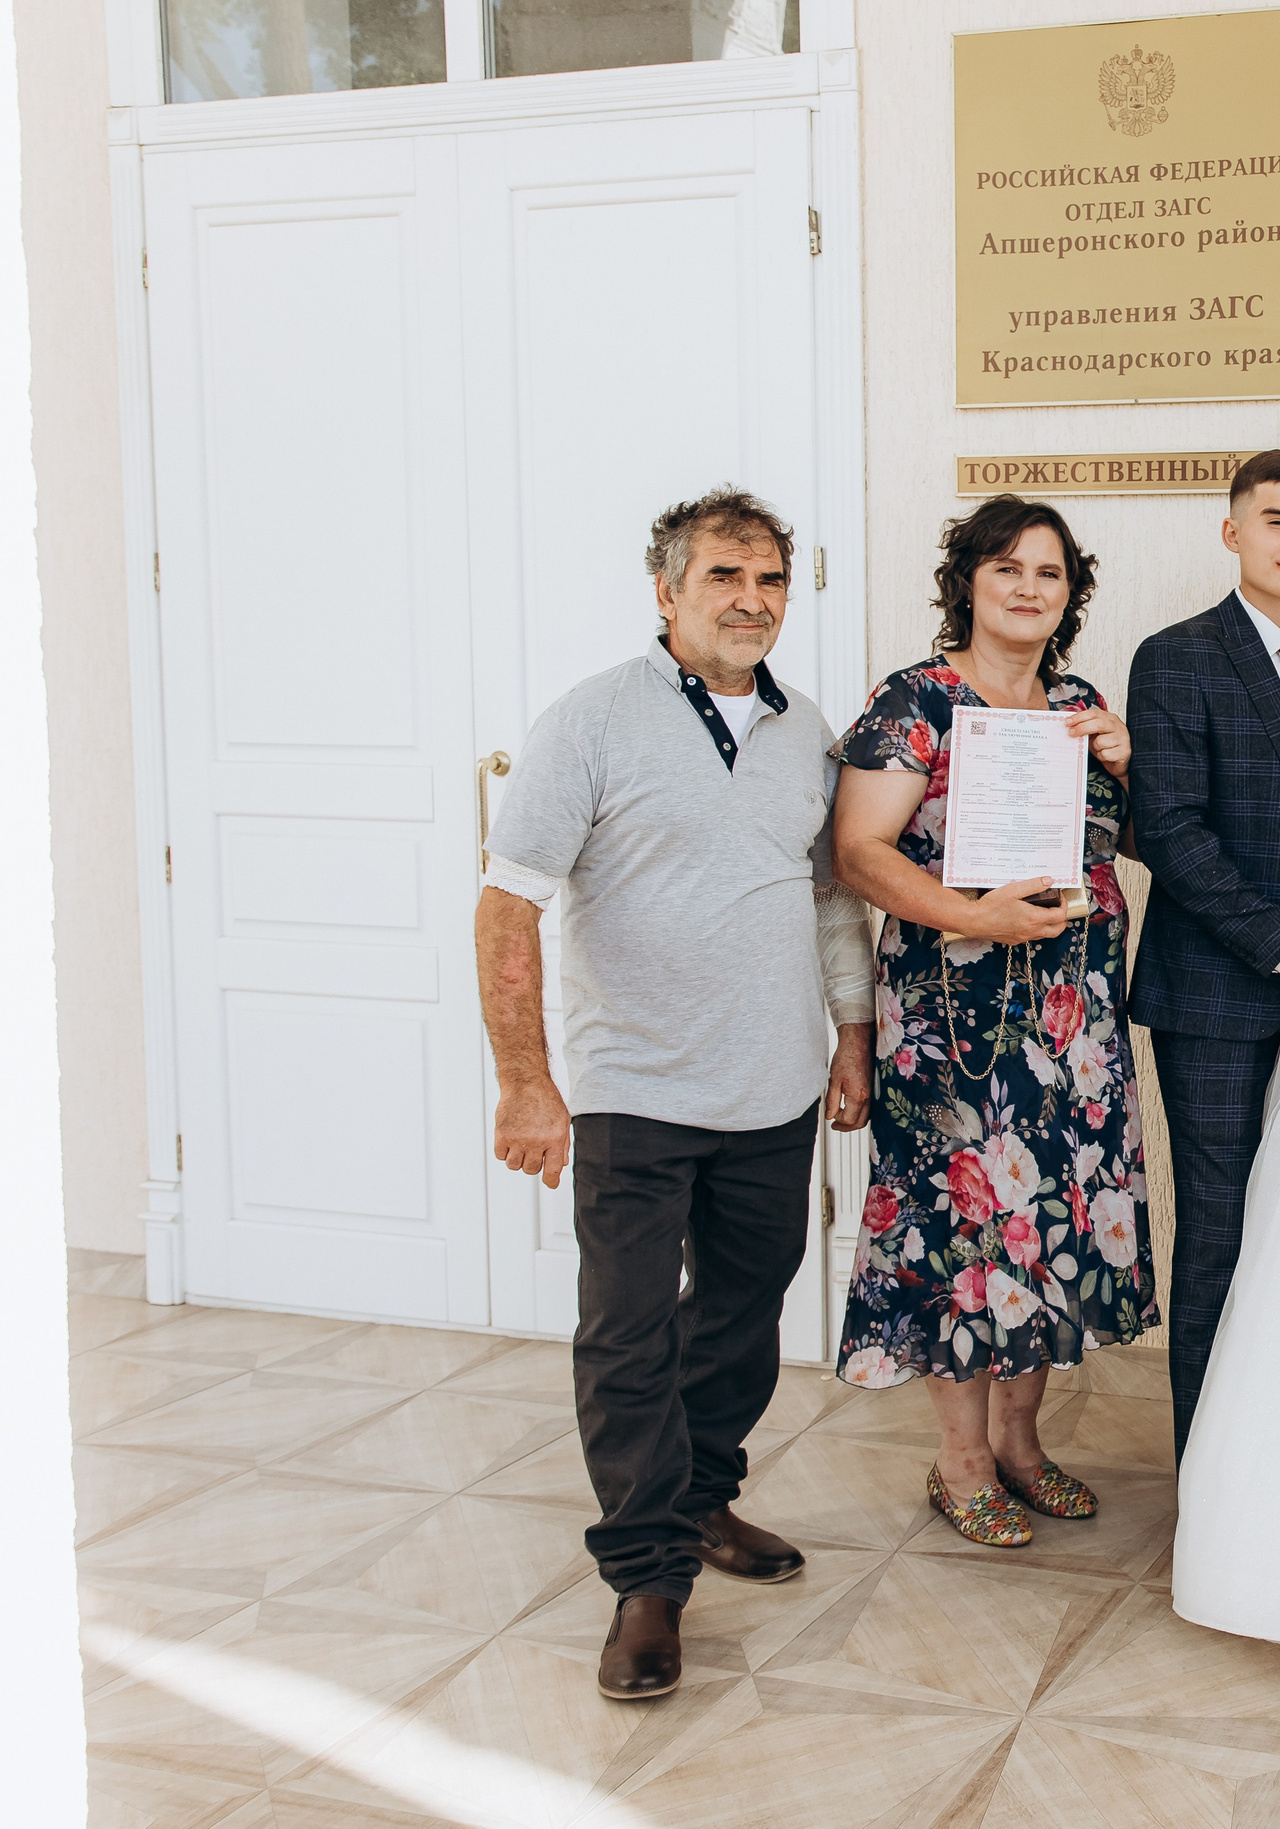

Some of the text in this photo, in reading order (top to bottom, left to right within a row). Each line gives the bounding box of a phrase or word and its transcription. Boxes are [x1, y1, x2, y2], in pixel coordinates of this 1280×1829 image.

[976, 164, 1140, 190] РОССИЙСКАЯ
[1065, 196, 1212, 223] ОТДЕЛ ЗАГС
[979, 231, 1185, 259] Апшеронского
[1008, 294, 1264, 333] управления ЗАГС
[981, 350, 1212, 378] Краснодарского
[964, 454, 1242, 485] ТОРЖЕСТВЕННЫЙ
